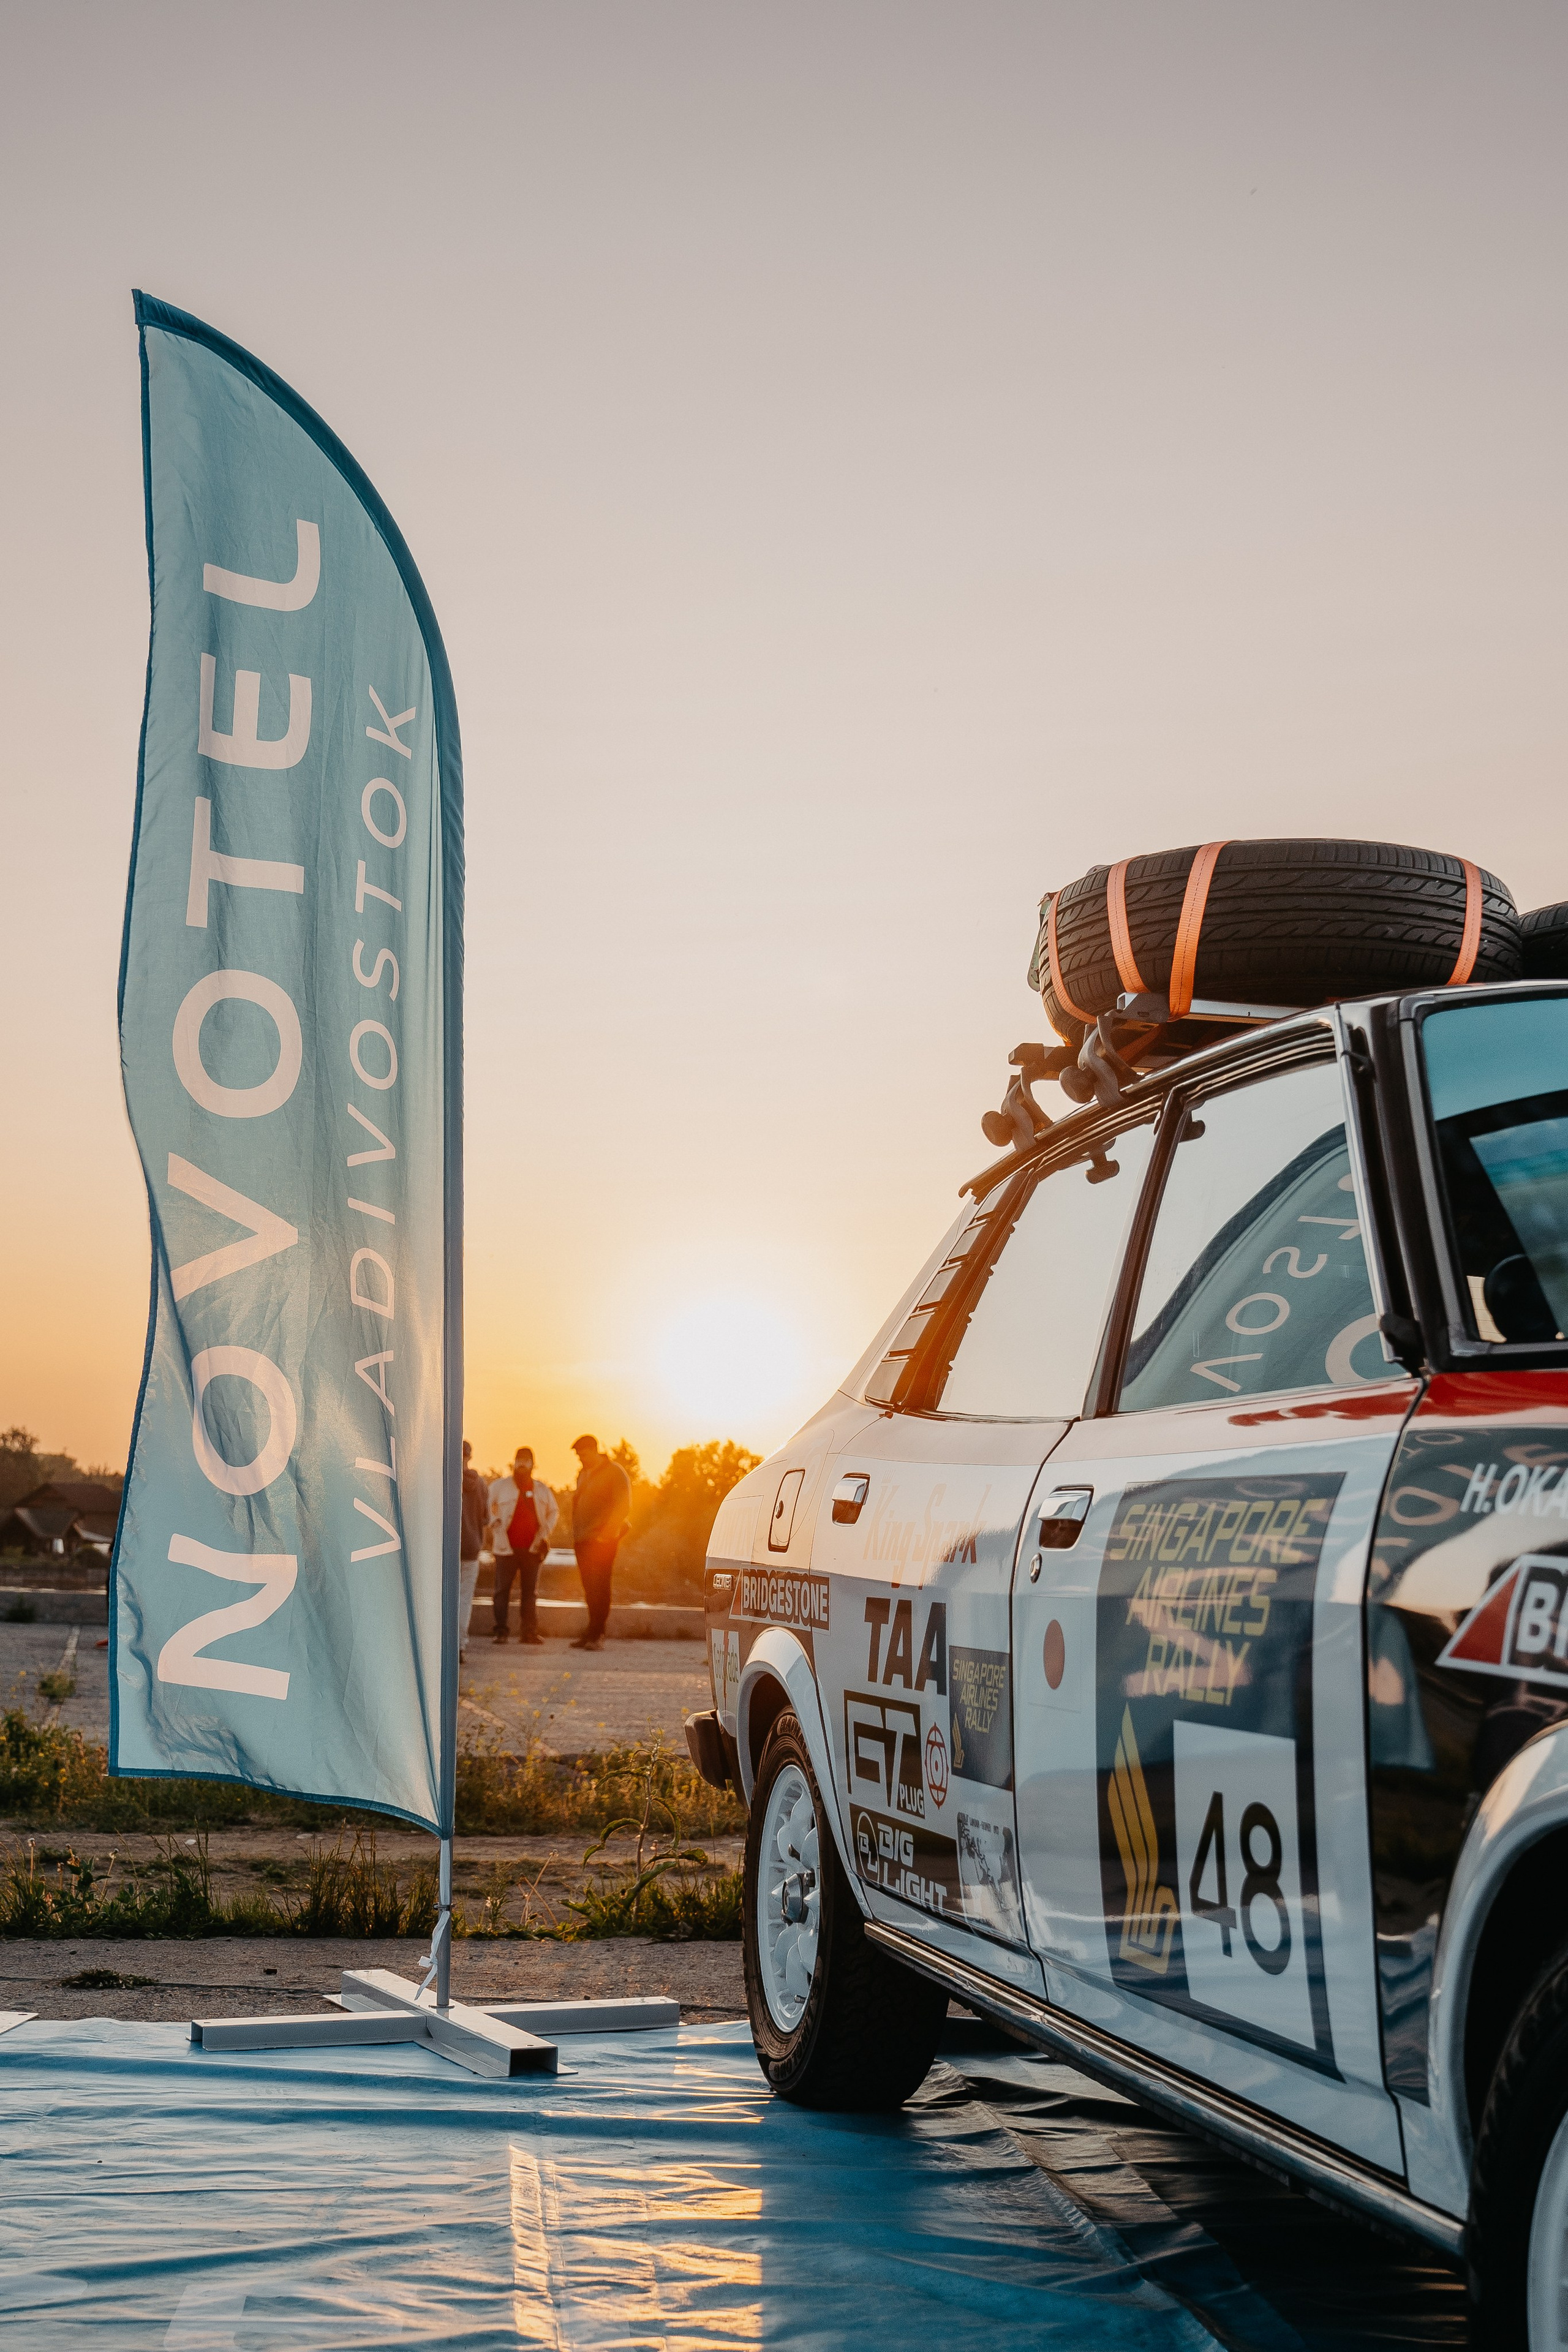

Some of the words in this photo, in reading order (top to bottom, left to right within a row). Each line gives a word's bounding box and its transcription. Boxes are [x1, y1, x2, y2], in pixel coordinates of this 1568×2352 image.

[157, 519, 322, 1700] NOVOTEL
[346, 684, 417, 1562] VLADIVOSTOK
[862, 1485, 916, 1589] King
[1109, 1498, 1328, 1564] SINGAPORE
[743, 1575, 828, 1623] BRIDGESTONE
[1125, 1566, 1277, 1636] AIRLINES
[864, 1597, 947, 1696] TAA
[952, 1659, 1006, 1689] SINGAPORE
[1141, 1633, 1251, 1706] RALLY
[960, 1683, 999, 1711] AIRLINES
[965, 1706, 993, 1734] RALLY
[899, 1783, 924, 1815] PLUG
[877, 1822, 914, 1868] BIG
[883, 1861, 948, 1916] LIGHT
[1188, 1791, 1291, 1976] 48
